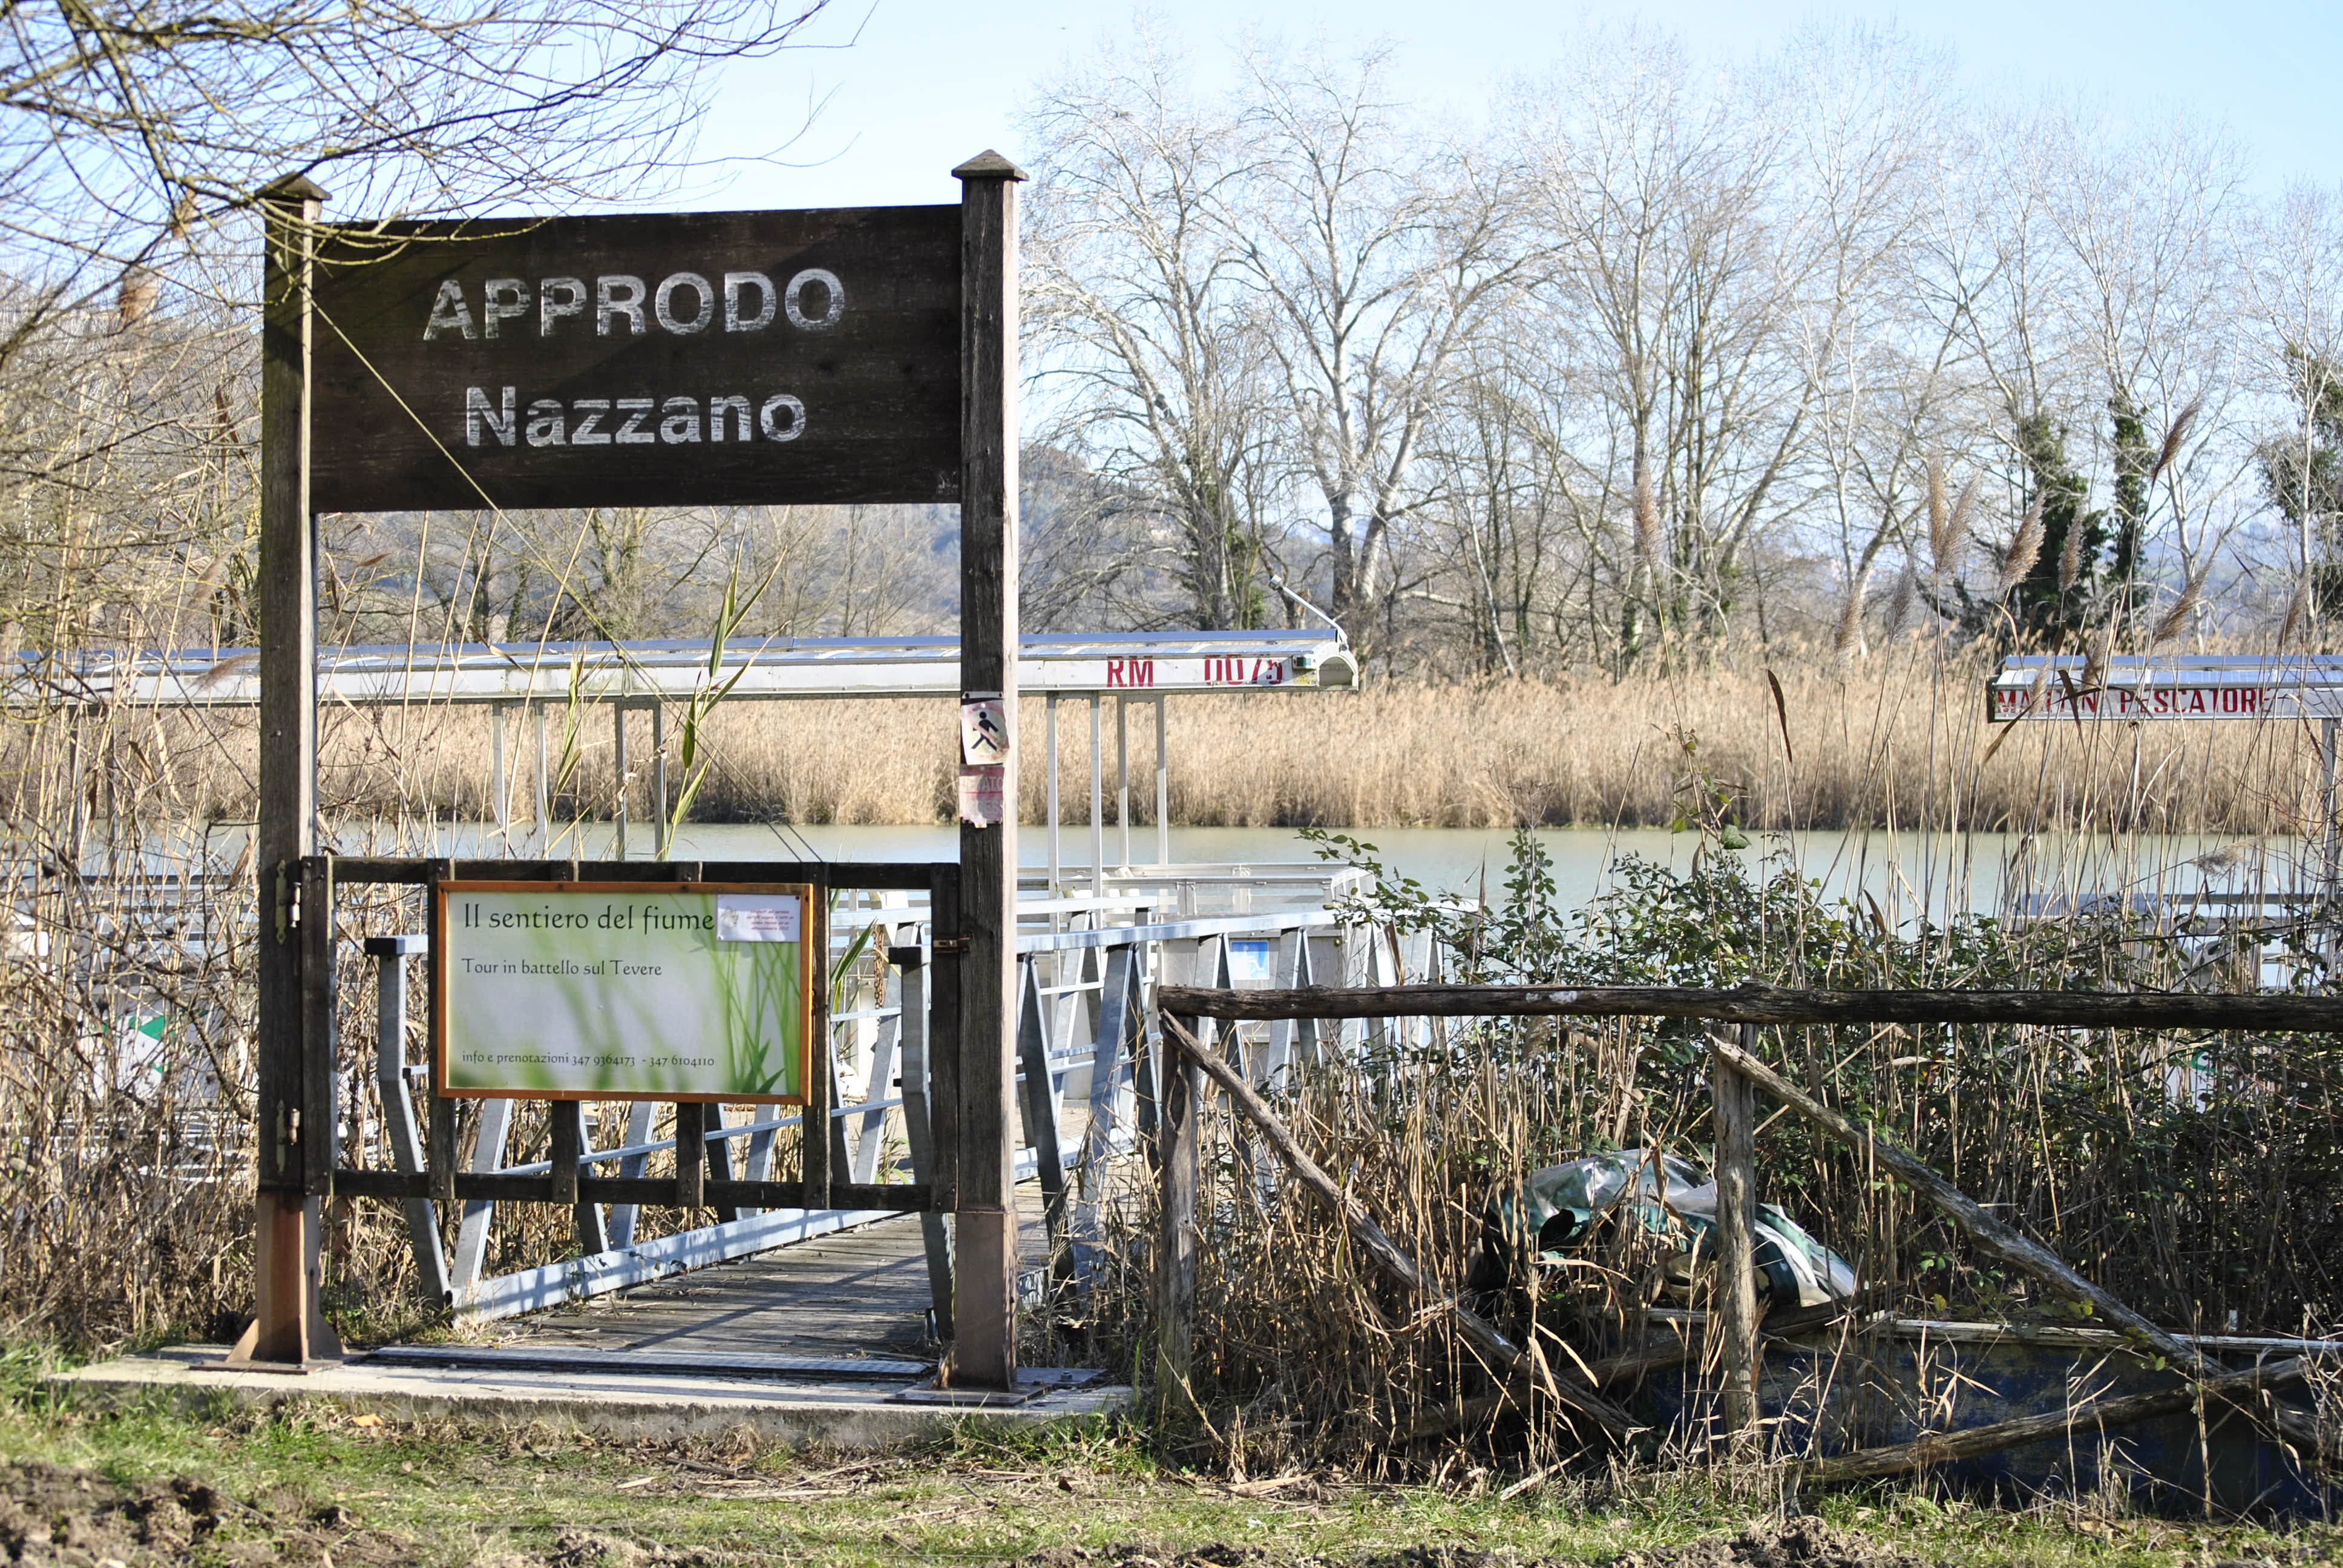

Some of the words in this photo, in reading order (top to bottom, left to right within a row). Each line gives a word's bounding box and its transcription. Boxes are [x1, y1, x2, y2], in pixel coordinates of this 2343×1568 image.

[423, 268, 846, 341] APPRODO
[465, 385, 807, 447] Nazzano
[1107, 655, 1153, 688] RM
[465, 903, 480, 929] Il
[488, 905, 589, 929] sentiero
[597, 904, 634, 930] del
[643, 905, 715, 935] fiume
[461, 958, 499, 974] Tour
[503, 959, 516, 973] in
[521, 959, 579, 975] battello
[583, 960, 605, 975] sul
[609, 959, 663, 976] Tevere
[462, 1050, 485, 1064] info
[487, 1054, 494, 1062] e
[497, 1051, 569, 1065] prenotazioni
[572, 1055, 590, 1067] 347
[594, 1053, 635, 1067] 9364173
[649, 1057, 668, 1068] 347
[671, 1054, 715, 1068] 6104110
